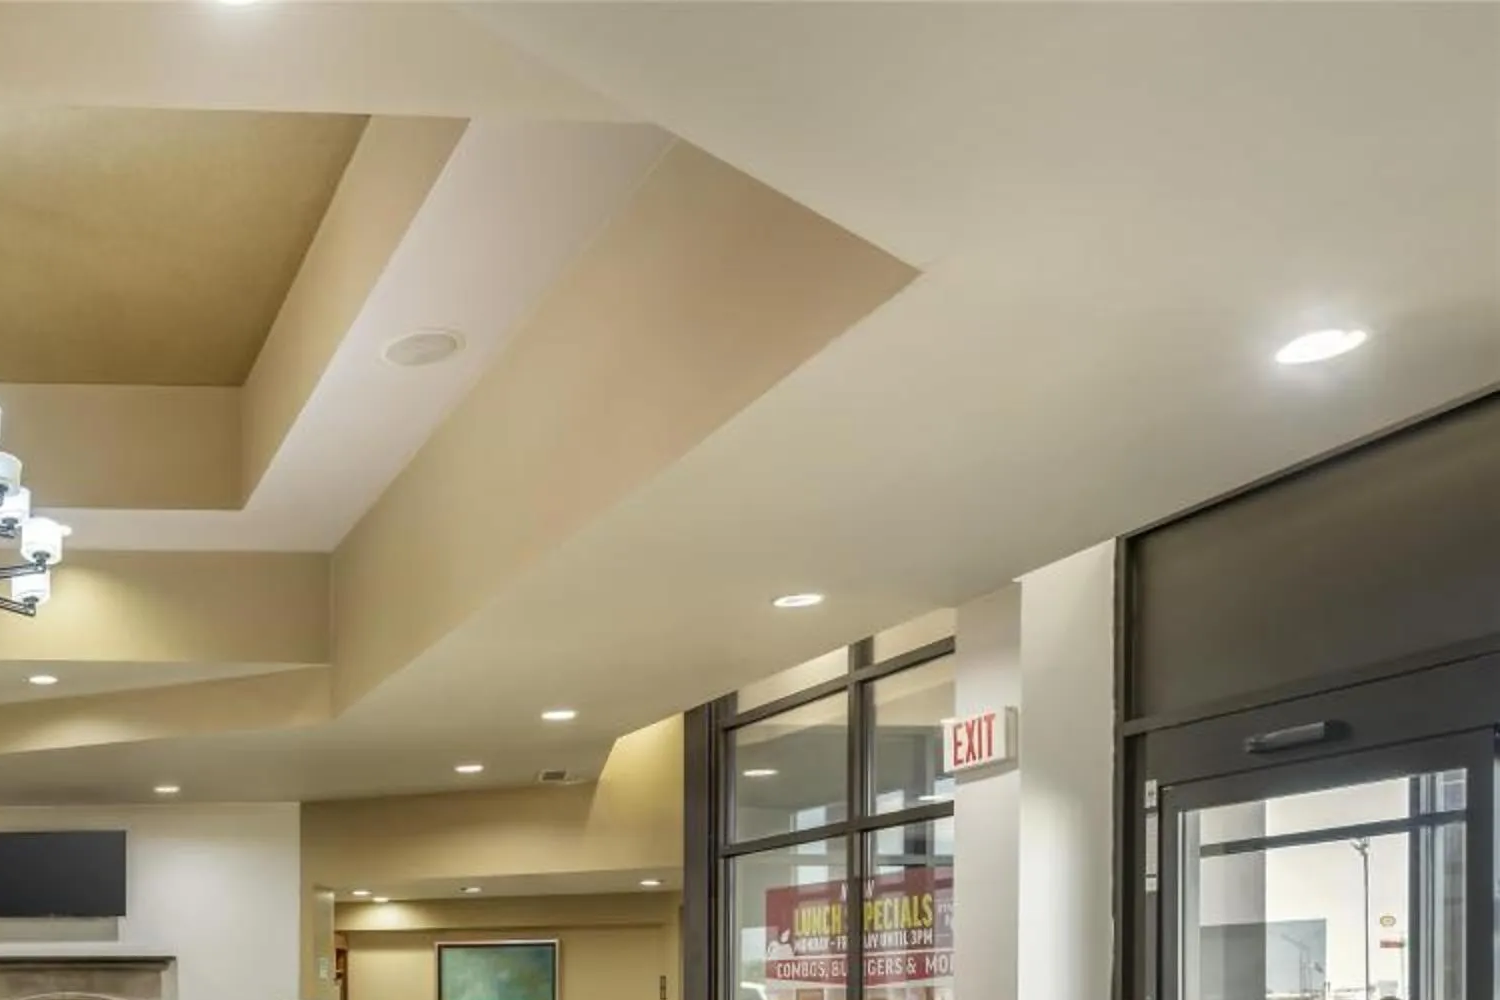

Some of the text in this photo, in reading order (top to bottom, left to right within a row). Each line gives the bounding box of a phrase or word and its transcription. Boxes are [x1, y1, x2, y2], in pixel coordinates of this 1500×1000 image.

[953, 713, 995, 767] EXIT
[793, 903, 842, 937] LUNCH
[844, 893, 933, 932] PECIALS
[909, 928, 933, 945] 3PM
[831, 957, 903, 977] BUGERS
